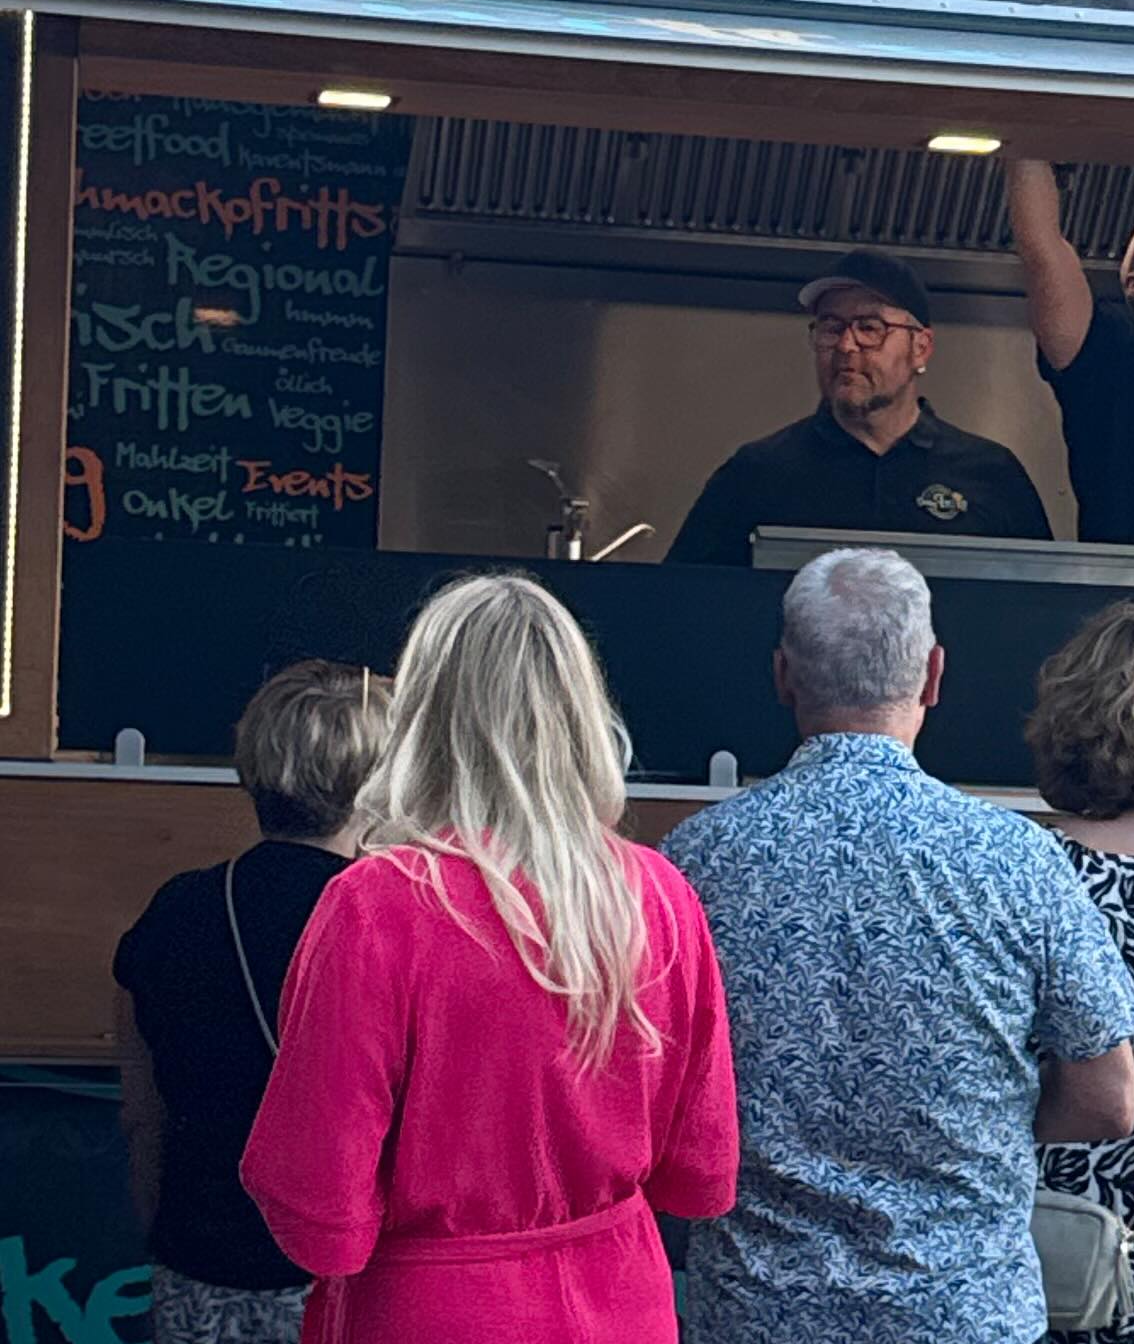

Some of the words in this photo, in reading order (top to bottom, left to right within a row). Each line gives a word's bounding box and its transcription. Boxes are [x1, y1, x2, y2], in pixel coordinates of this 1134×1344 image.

[78, 113, 231, 168] eetfood
[167, 233, 384, 324] Regional
[71, 281, 218, 354] isch
[81, 360, 254, 433] Fritten
[268, 398, 375, 455] Veggie
[114, 441, 235, 484] Mahlzeit
[235, 459, 376, 513] Events
[121, 486, 235, 535] Onkel
